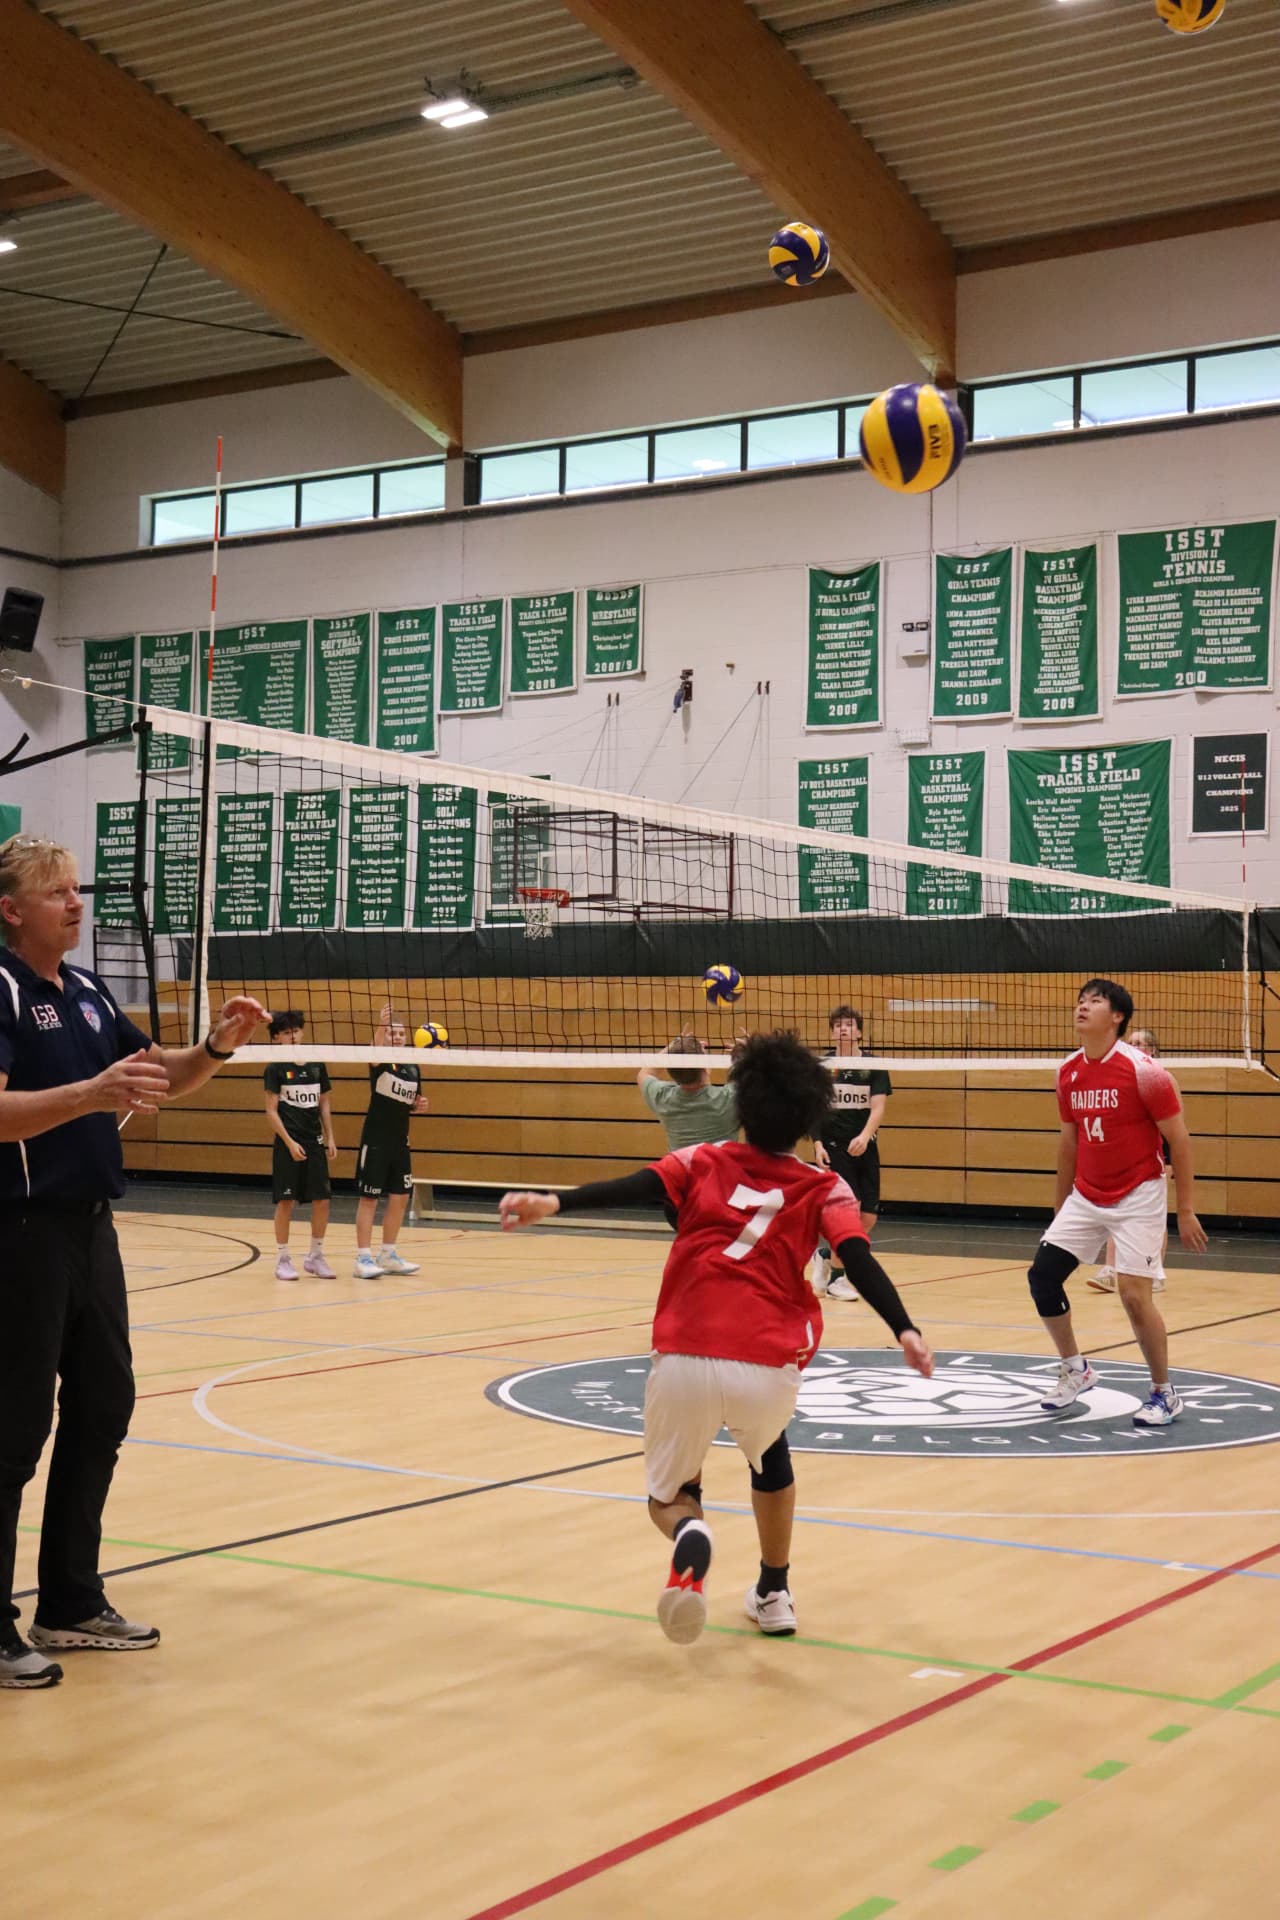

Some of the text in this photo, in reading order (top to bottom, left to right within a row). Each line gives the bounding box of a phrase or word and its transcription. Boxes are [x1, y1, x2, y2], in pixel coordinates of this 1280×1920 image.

[1165, 529, 1224, 552] ISST
[1171, 549, 1218, 562] DIVISION II
[956, 562, 990, 575] ISST
[1043, 557, 1076, 571] ISST
[1163, 560, 1226, 578] TENNIS
[828, 578, 860, 588] ISST
[948, 577, 1000, 589] GIRLS TENNIS
[1054, 573, 1078, 583] GIRLS
[1035, 581, 1084, 594] BASKETBALL
[529, 597, 557, 608] ISST
[818, 595, 841, 604] TRACK
[849, 591, 870, 602] FIELD
[951, 592, 996, 603] CHAMPIONS
[1037, 592, 1081, 604] CHAMPIONS
[460, 604, 486, 615] ISST
[520, 608, 567, 620] TRACK FIELD
[592, 607, 636, 620] WRESTLING
[330, 619, 355, 629] ISST
[396, 619, 419, 630] ISST
[450, 615, 496, 626] TRACK FIELD
[239, 627, 266, 640] ISST
[402, 633, 430, 642] COUNTRY
[321, 636, 362, 650] SOFTBALL
[323, 647, 360, 658] CHAMPIONS
[955, 693, 988, 706] 2009
[1043, 697, 1075, 711] 2009
[828, 704, 857, 716] 2009
[929, 758, 962, 771] ISST
[1059, 751, 1117, 773] ISST
[1214, 754, 1246, 763] NECIS
[817, 762, 849, 775] ISST
[809, 780, 824, 789] BOYS
[826, 777, 868, 788] BASKETBALL
[930, 774, 961, 783] JV BOYS
[1037, 768, 1141, 787] TRACK & FIELD
[811, 788, 856, 799] CHAMPIONS
[921, 783, 971, 794] BASKETBALL
[1054, 783, 1122, 794] COMBINED CHAMPIONS
[923, 793, 969, 804] CHAMPIONS
[109, 807, 135, 821] ISST
[117, 826, 135, 834] GIRLS
[286, 819, 336, 830] TRACK FIELD
[99, 838, 119, 846] TRACK
[230, 914, 252, 925] 2016
[363, 910, 387, 920] 2017
[1070, 1088, 1119, 1110] RAIDERS
[1084, 1116, 1105, 1143] 14
[722, 1183, 785, 1261] 7
[814, 1427, 1168, 1446] BELGIUM
